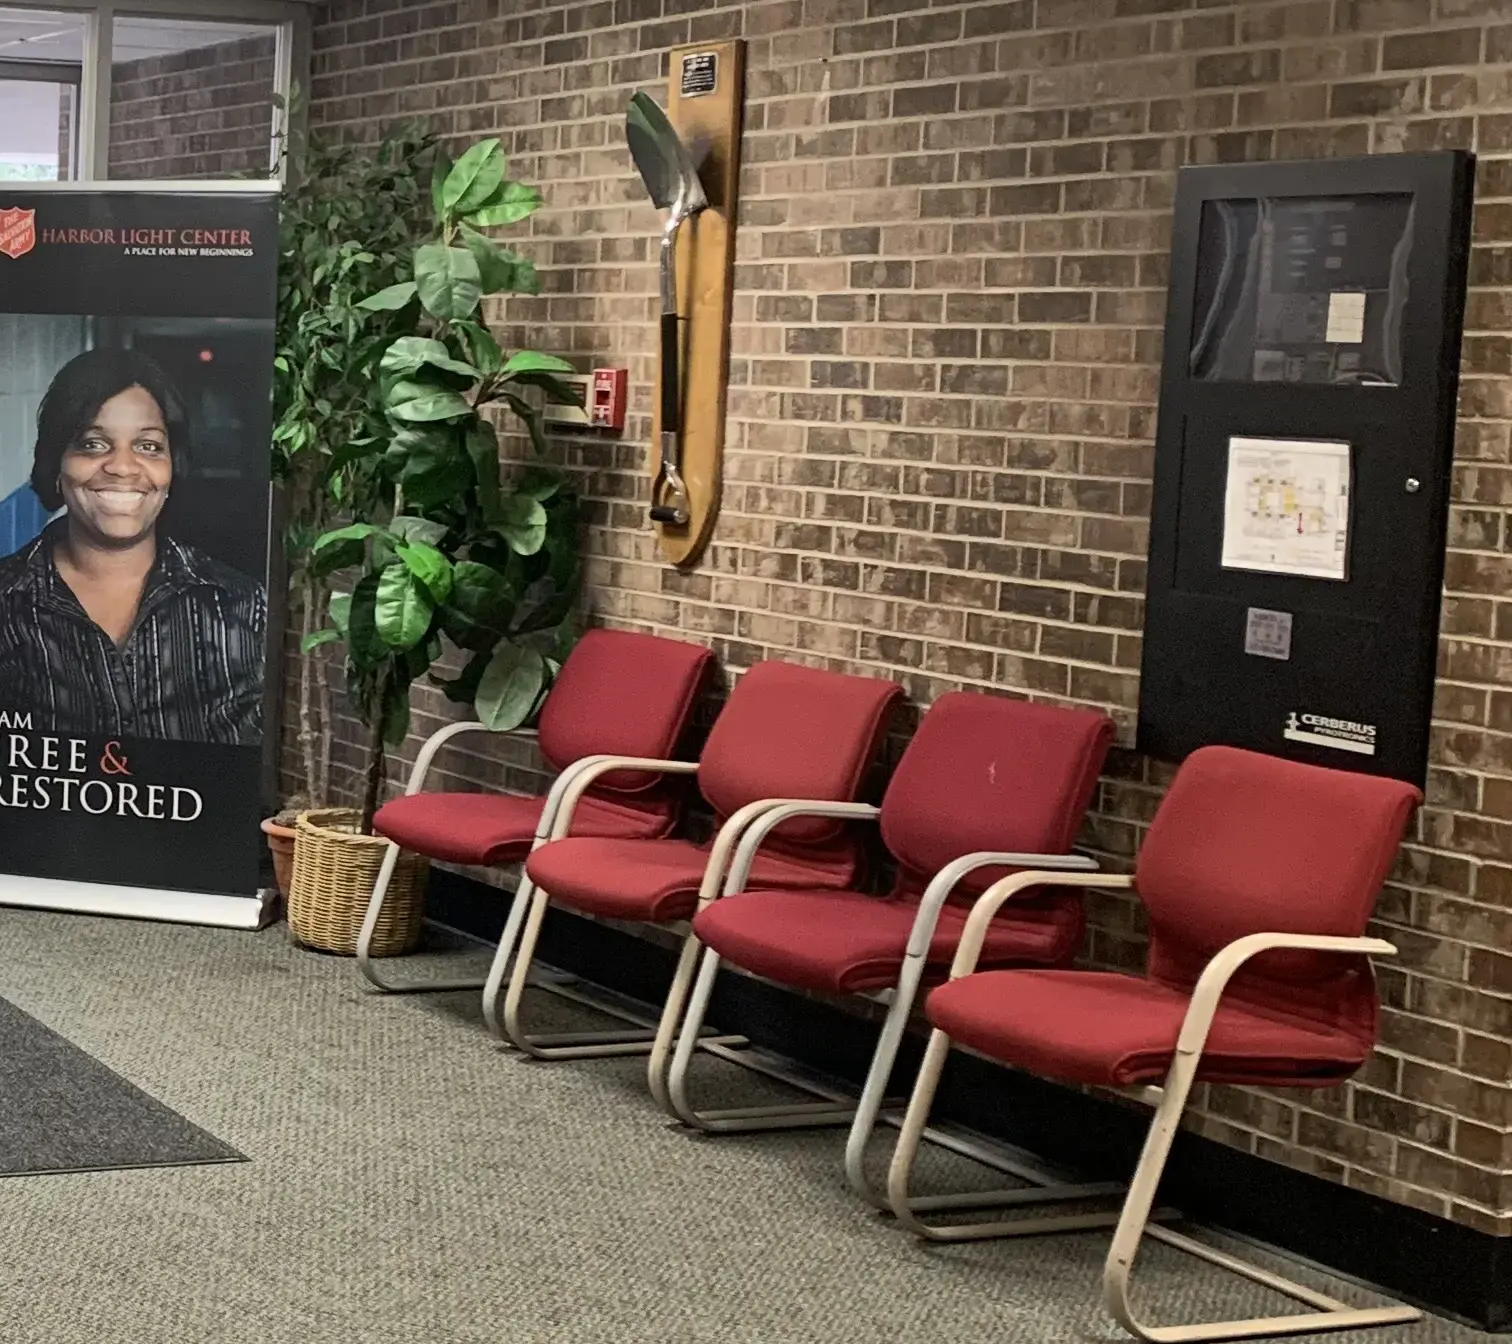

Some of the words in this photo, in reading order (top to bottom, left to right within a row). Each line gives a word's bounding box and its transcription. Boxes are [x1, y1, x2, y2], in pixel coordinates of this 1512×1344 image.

[3, 212, 19, 228] THE
[42, 228, 116, 244] HARBOR
[121, 229, 176, 244] LIGHT
[180, 229, 252, 245] CENTER
[123, 247, 131, 255] A
[131, 247, 157, 255] PLACE
[158, 247, 176, 256] FOR
[177, 248, 199, 256] NEW
[199, 248, 254, 257] BEGINNINGS
[1301, 713, 1377, 736] CERBERUS
[99, 740, 133, 775] &
